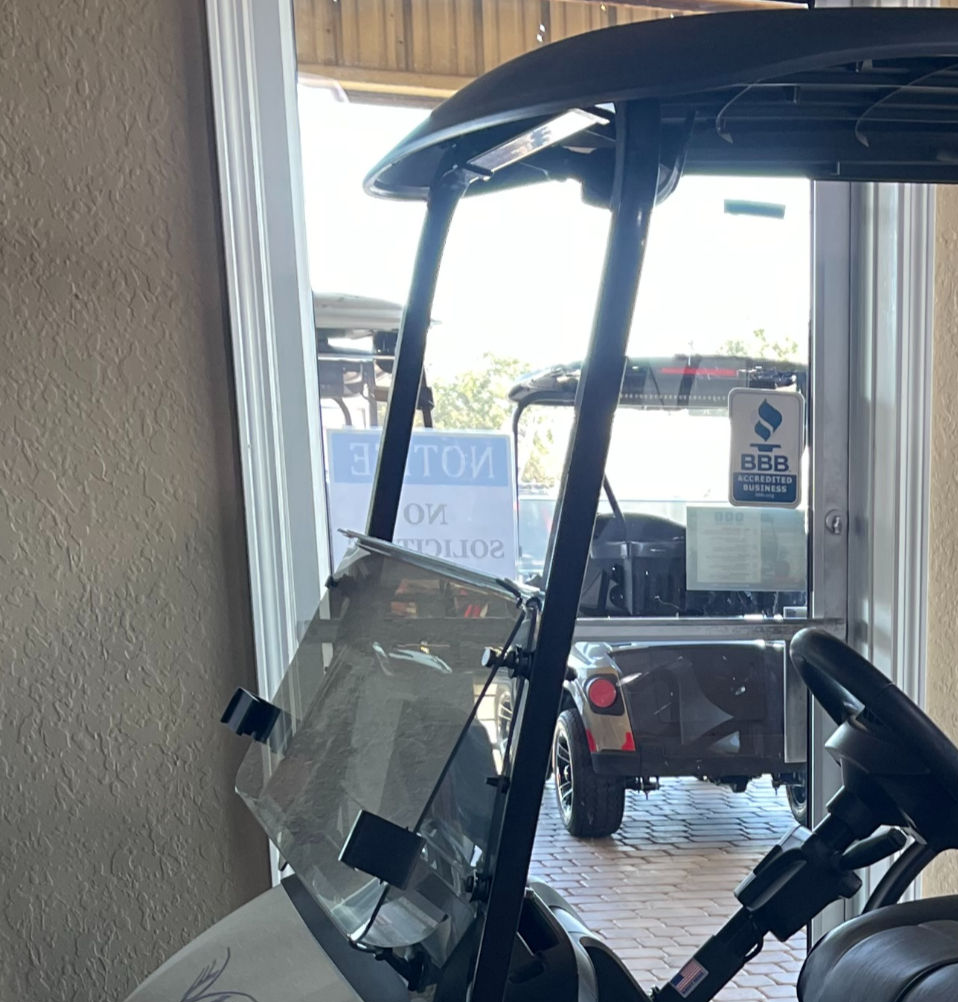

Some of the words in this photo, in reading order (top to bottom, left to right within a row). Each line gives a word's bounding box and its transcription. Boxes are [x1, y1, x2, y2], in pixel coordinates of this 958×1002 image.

[741, 454, 789, 472] BBB
[737, 474, 793, 485] ACCREDITED
[743, 484, 788, 493] BUSINESS
